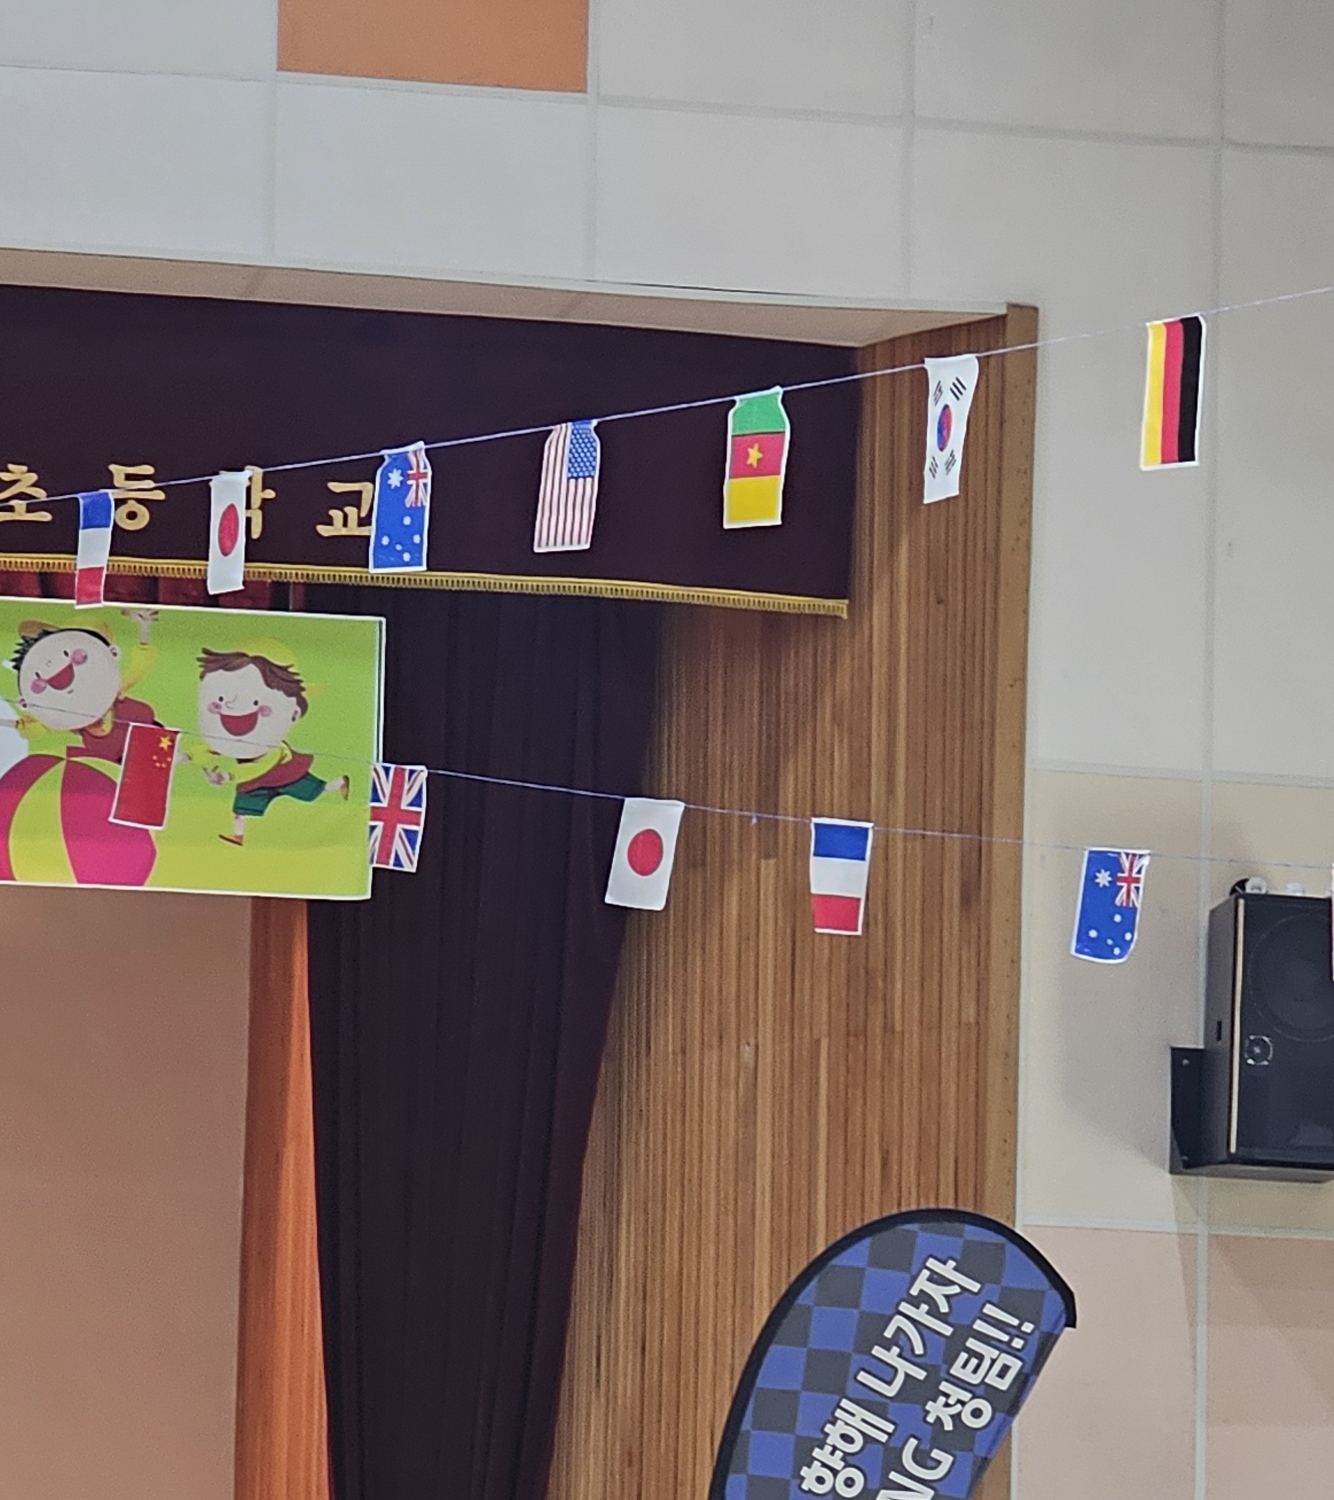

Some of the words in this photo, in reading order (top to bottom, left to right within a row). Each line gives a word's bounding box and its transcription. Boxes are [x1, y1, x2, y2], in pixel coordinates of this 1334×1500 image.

[799, 1397, 896, 1499] 향해
[856, 1256, 982, 1398] 나가자
[924, 1302, 1036, 1432] 청팀!!
